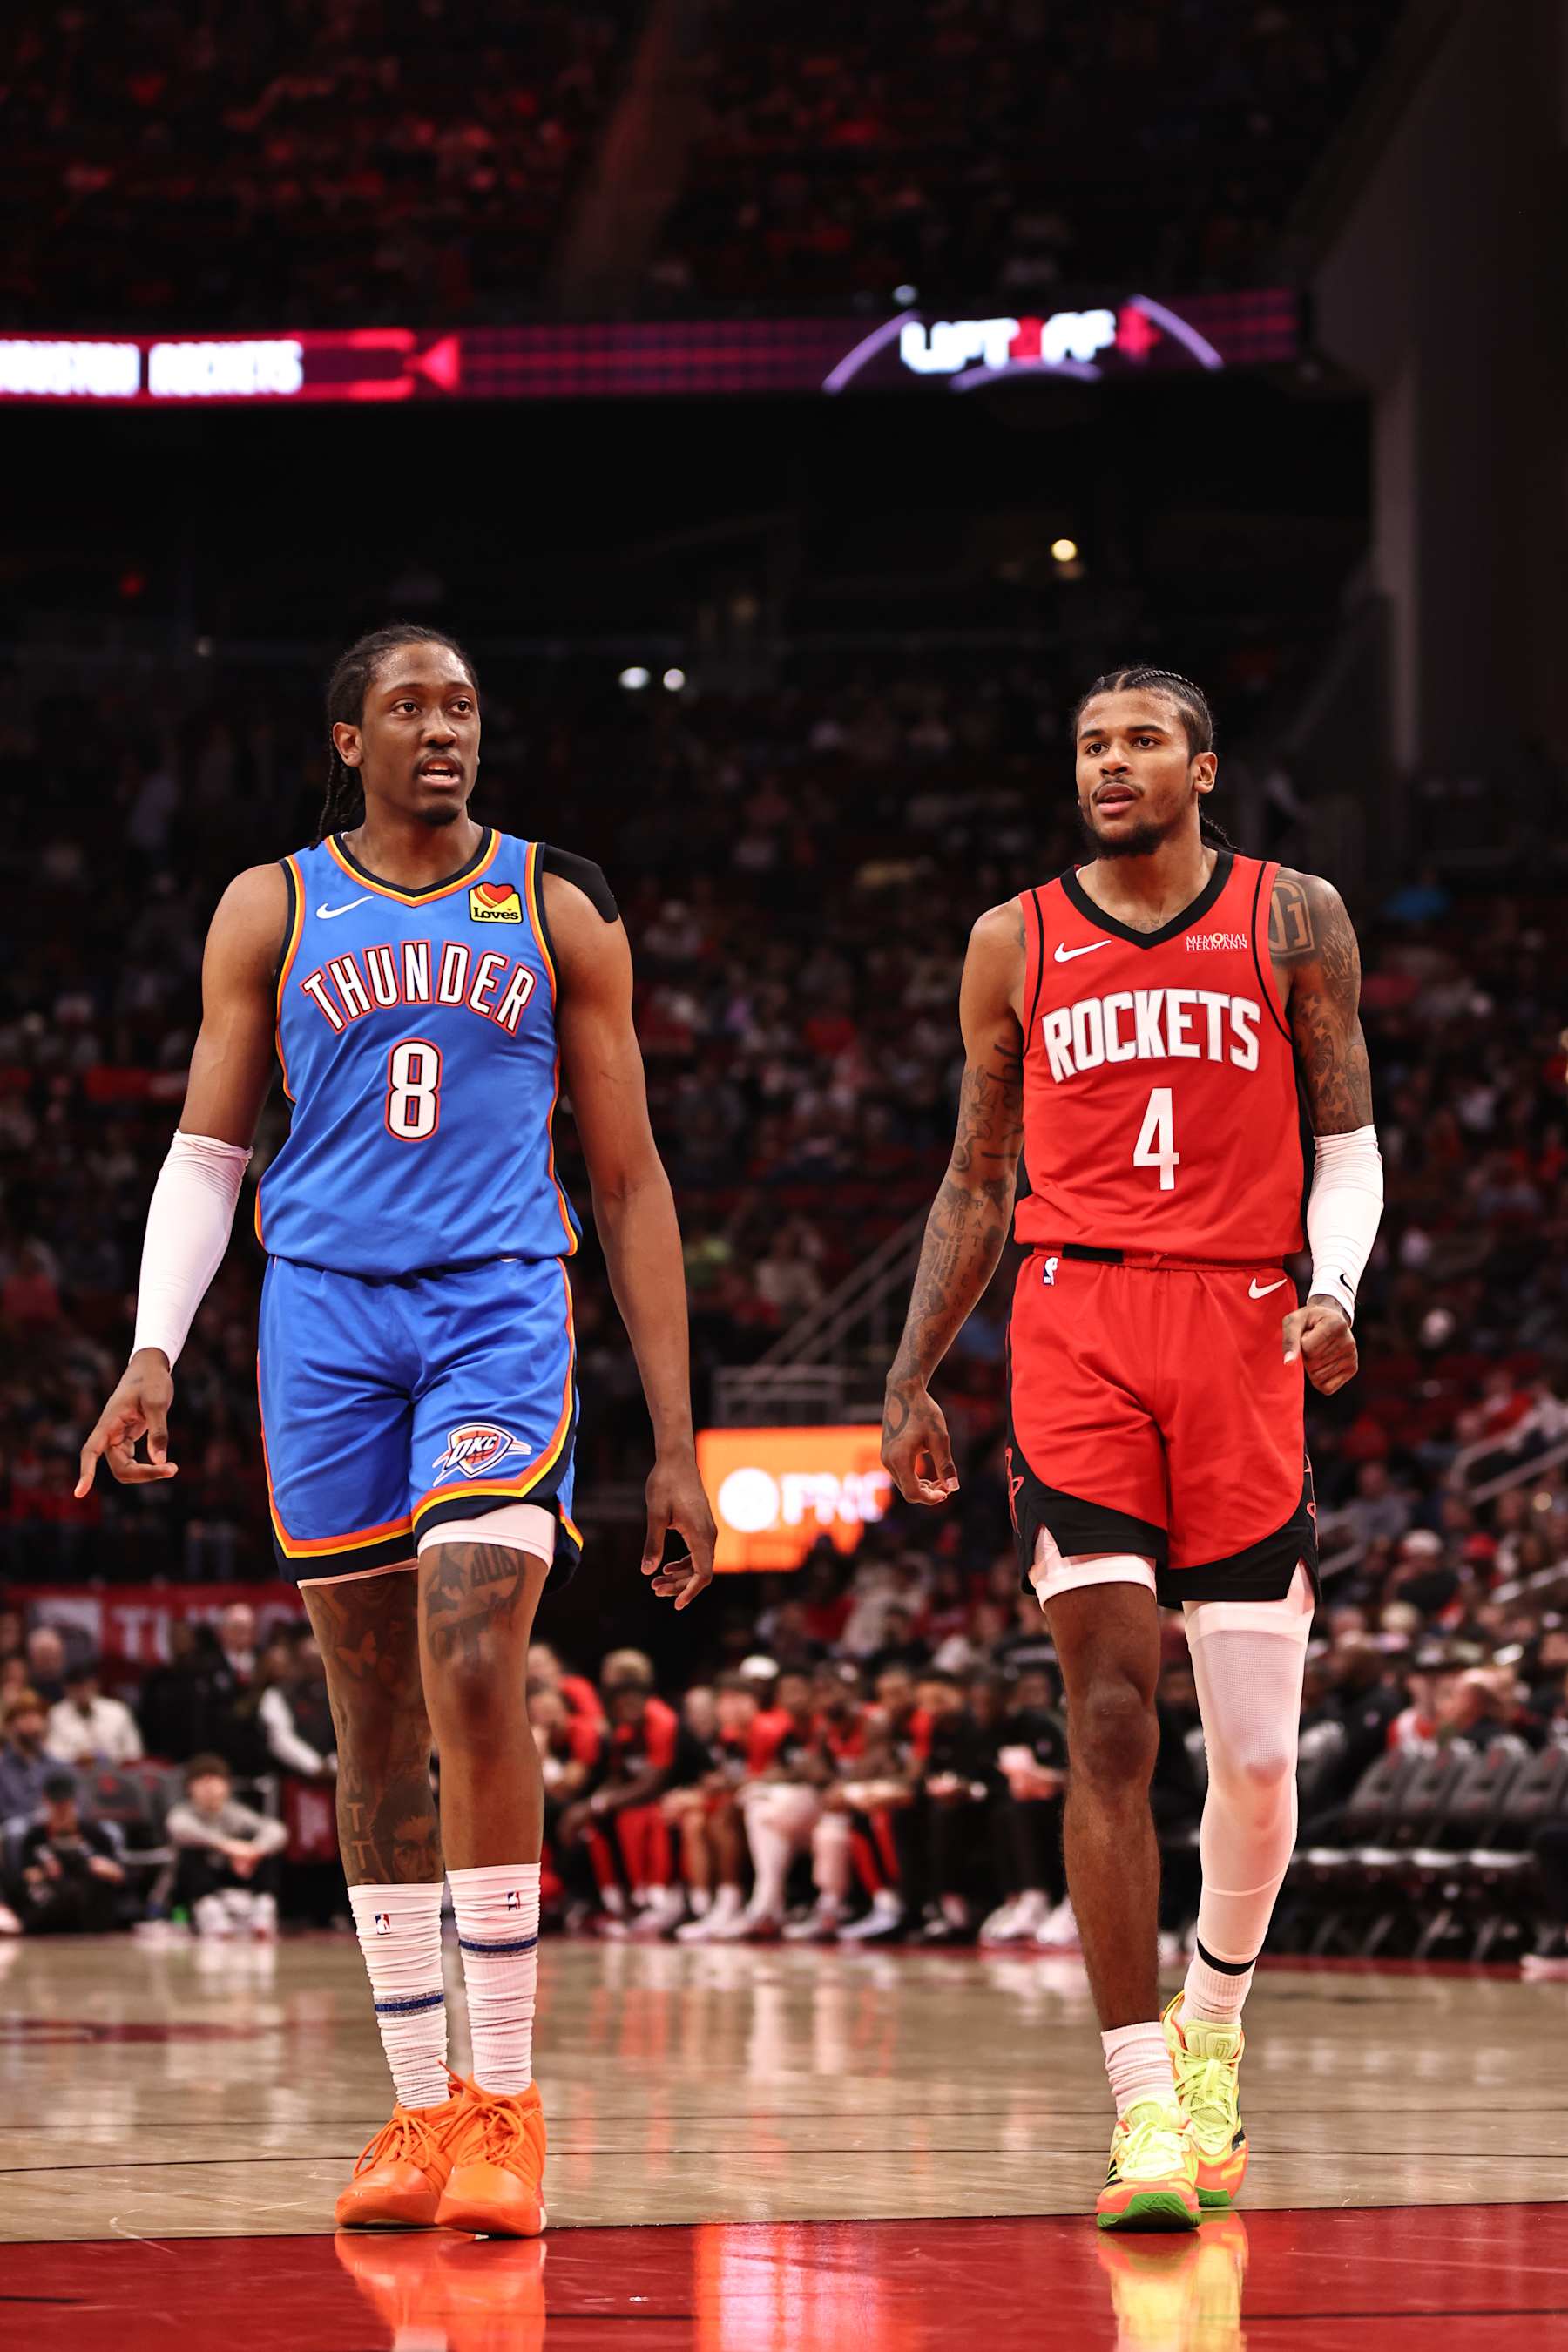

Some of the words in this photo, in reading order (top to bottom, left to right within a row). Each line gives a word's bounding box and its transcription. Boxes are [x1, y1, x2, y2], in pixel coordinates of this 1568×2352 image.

[1186, 933, 1247, 944] MEMORIAL
[1186, 941, 1247, 951] HERMANN
[300, 940, 537, 1037] THUNDER
[1042, 989, 1261, 1083] ROCKETS
[385, 1037, 442, 1143] 8
[1133, 1088, 1179, 1190] 4
[445, 1436, 498, 1470] OKC
